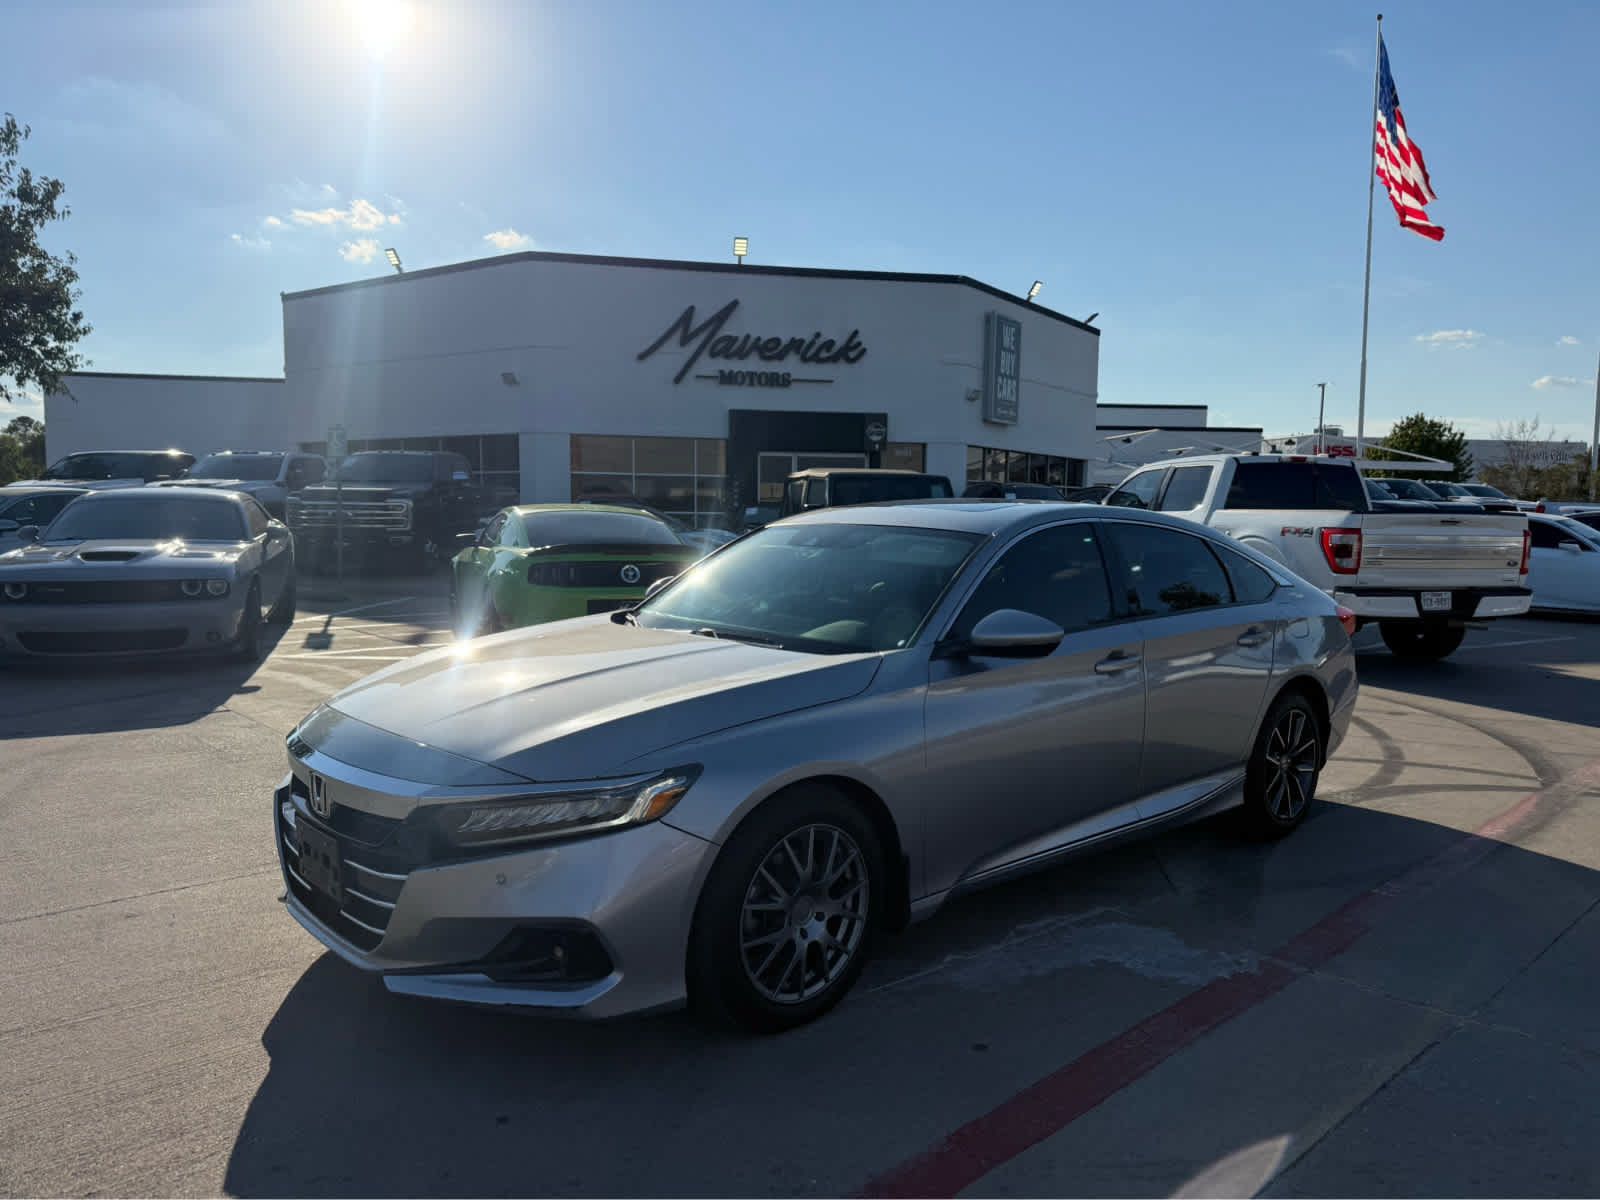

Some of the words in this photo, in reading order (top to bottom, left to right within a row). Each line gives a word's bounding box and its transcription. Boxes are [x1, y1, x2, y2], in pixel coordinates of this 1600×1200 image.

[636, 298, 868, 384] Maverick
[1001, 350, 1016, 376] BUY
[718, 369, 792, 388] MOTORS
[997, 376, 1017, 401] CARS
